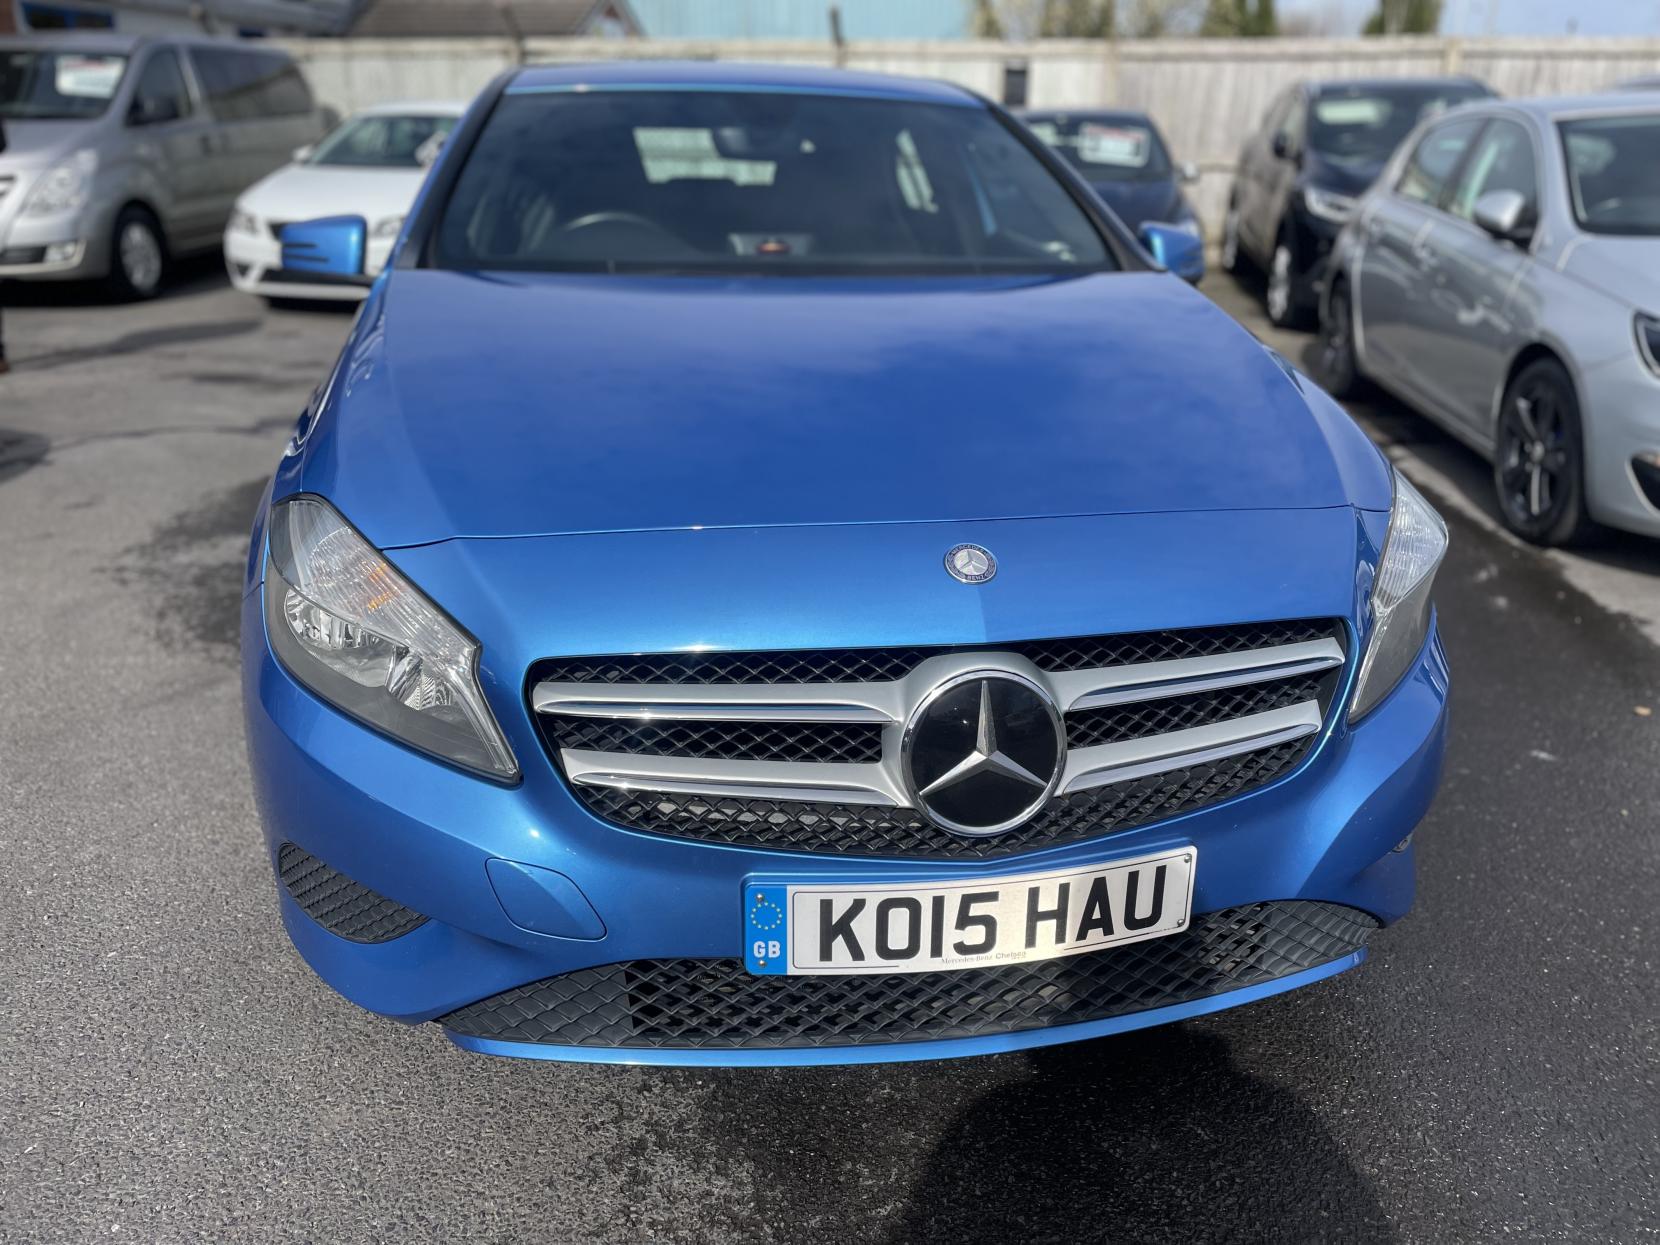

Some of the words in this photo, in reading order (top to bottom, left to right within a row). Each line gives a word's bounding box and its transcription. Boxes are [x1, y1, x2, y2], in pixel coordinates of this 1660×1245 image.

[820, 891, 999, 962] KO15
[1025, 865, 1167, 949] HAU
[753, 941, 781, 958] GB
